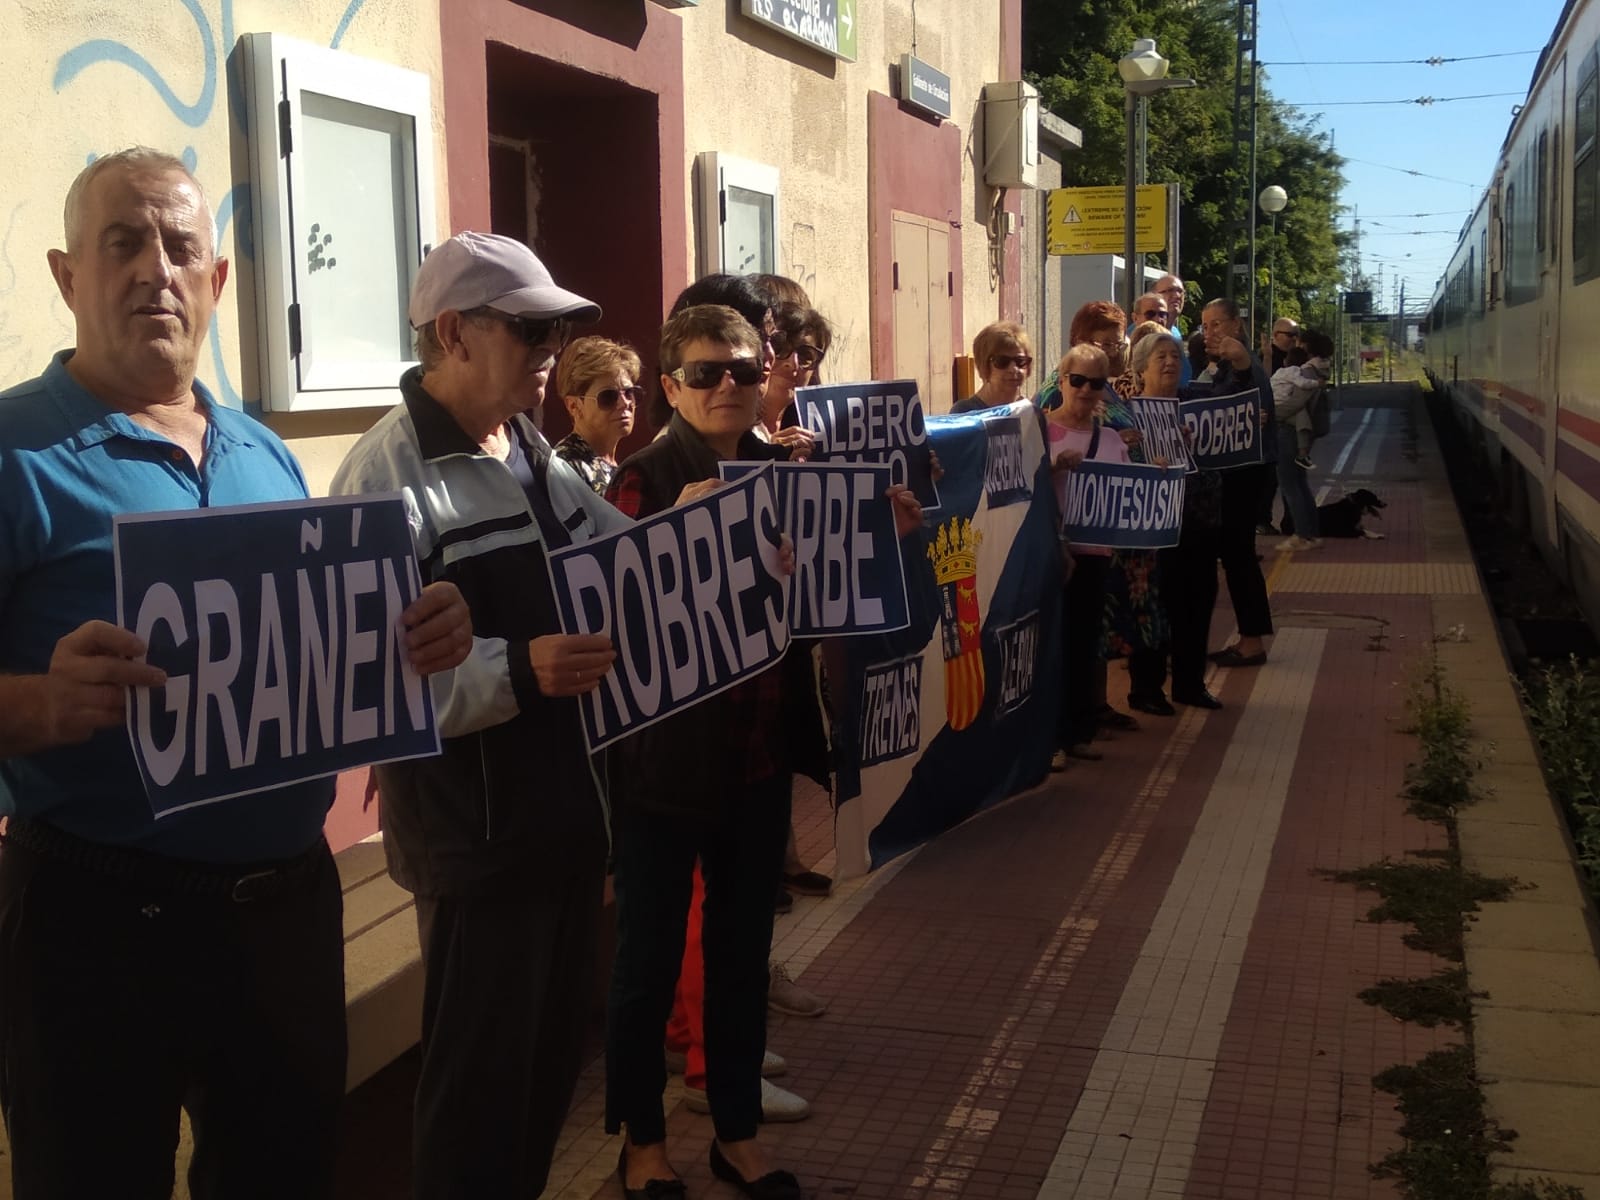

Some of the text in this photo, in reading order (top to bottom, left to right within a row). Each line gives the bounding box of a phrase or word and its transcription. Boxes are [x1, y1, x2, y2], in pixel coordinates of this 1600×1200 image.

[807, 394, 928, 454] ALBERO
[1065, 471, 1183, 531] MONTESUSIN
[133, 508, 428, 787] GRAÑÉN
[563, 476, 789, 738] ROBRES
[862, 662, 919, 761] TRENES
